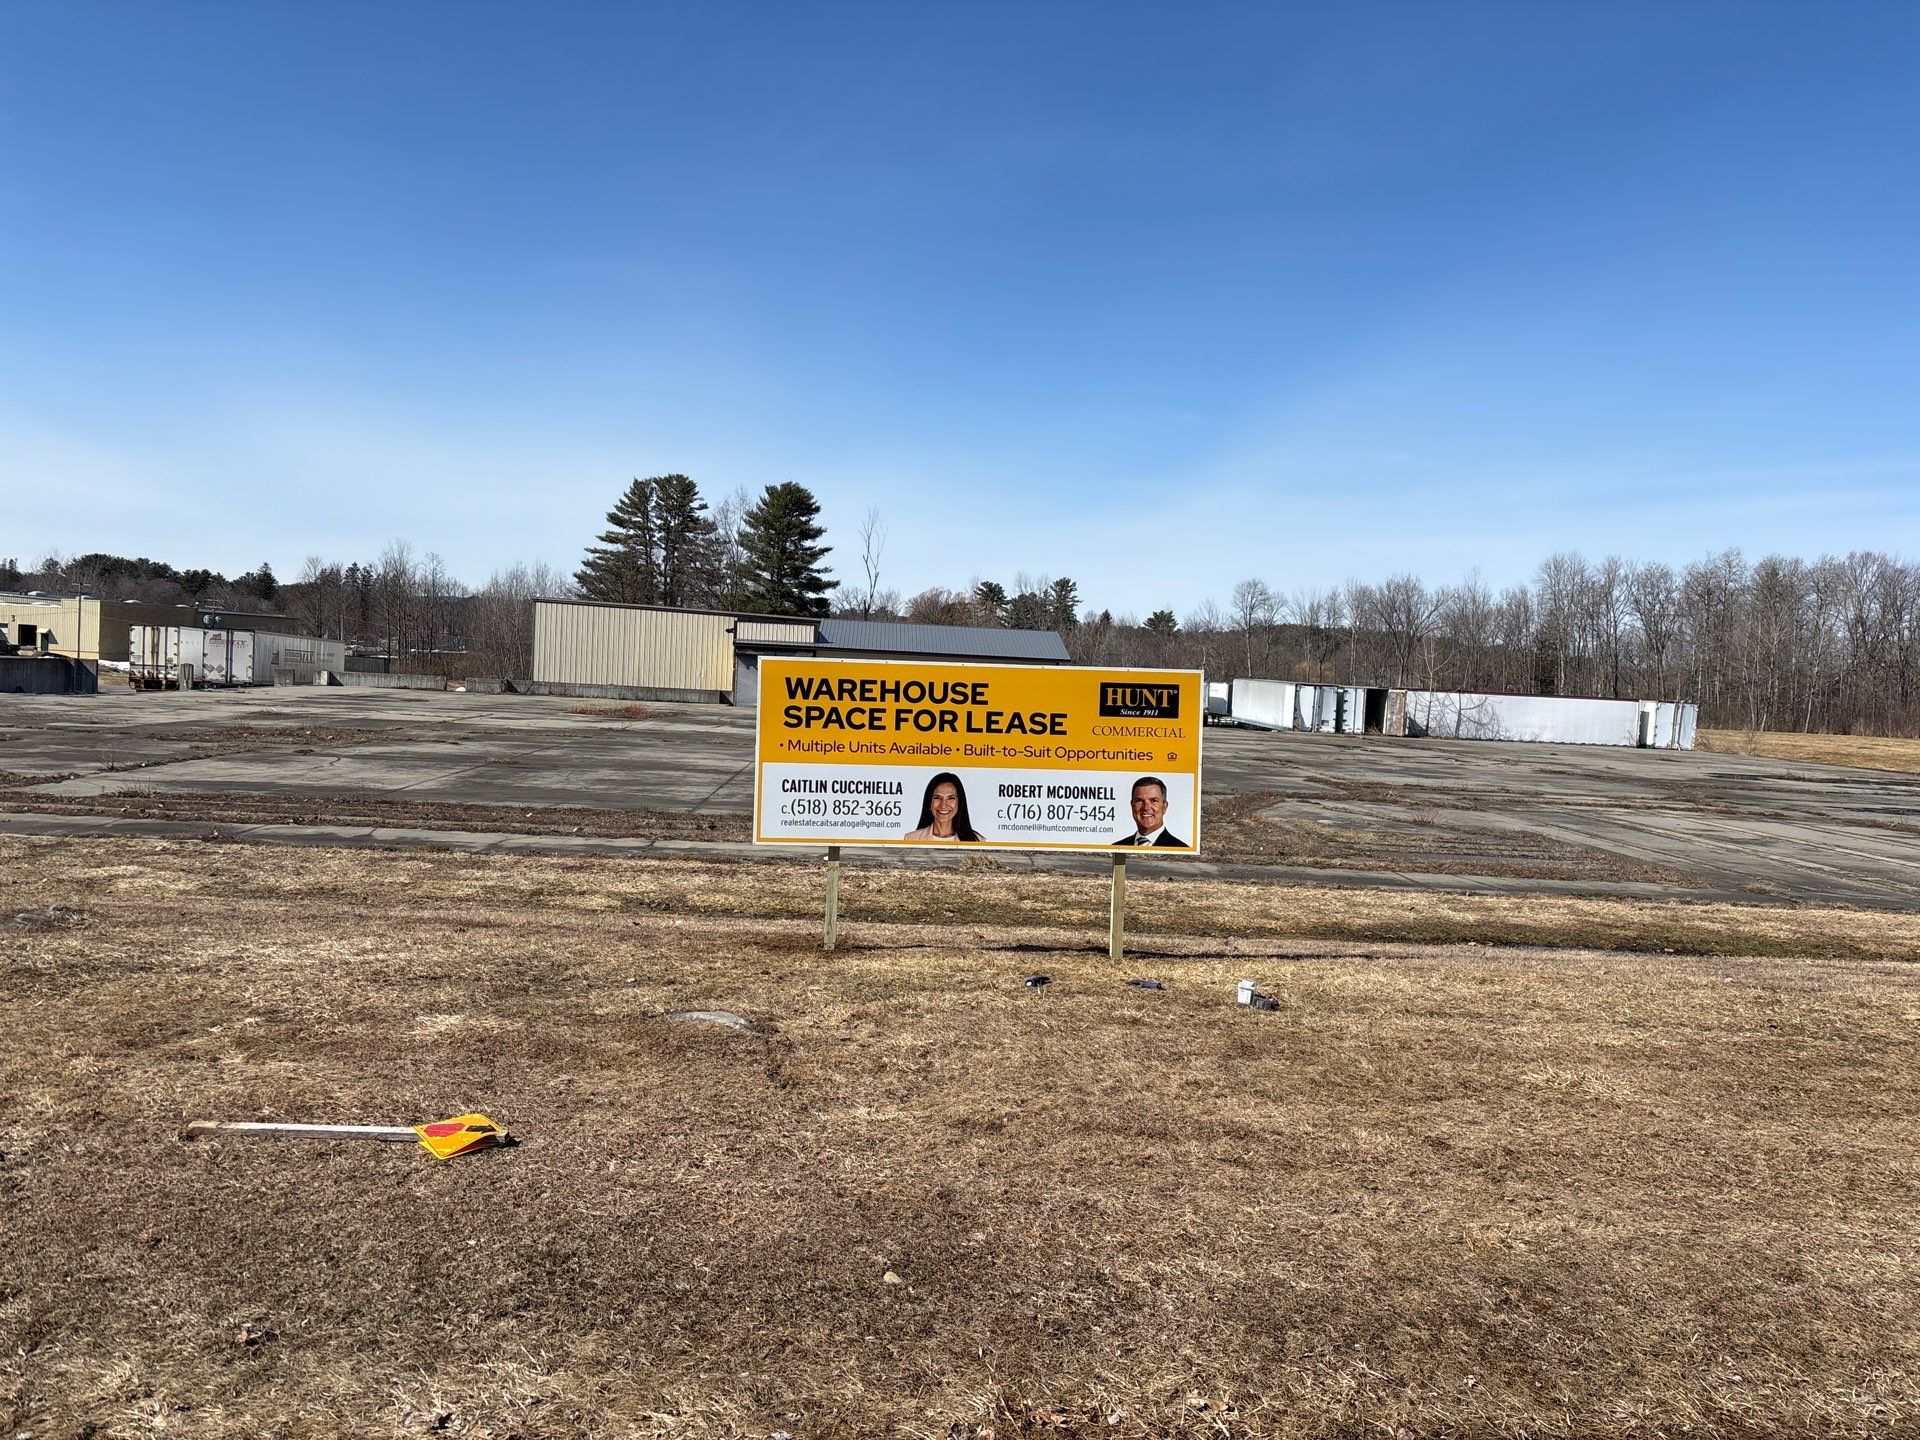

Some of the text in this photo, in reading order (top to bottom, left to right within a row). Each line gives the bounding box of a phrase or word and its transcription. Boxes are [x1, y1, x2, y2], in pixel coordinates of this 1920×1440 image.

[785, 676, 989, 705] WAREHOUSE
[1105, 687, 1174, 708] HUNT
[783, 705, 1067, 735] SPACE FOR LEASE
[1120, 708, 1141, 716] Since
[1092, 725, 1187, 738] COMMERCIAL
[788, 739, 1154, 762] Multiple Units Available Built-to-Suit Opportunities
[782, 779, 903, 795] CAITLIN CUCCHIELLA
[998, 784, 1116, 800] ROBERT MCDONNELL
[781, 798, 902, 816] c.(518) 852-3665
[997, 803, 1115, 821] c.(716) 807-5454
[781, 818, 901, 829] realestatecaitsaratoga@gmail.com
[998, 823, 1114, 833] rmcdonnell@huntcommercial.com
